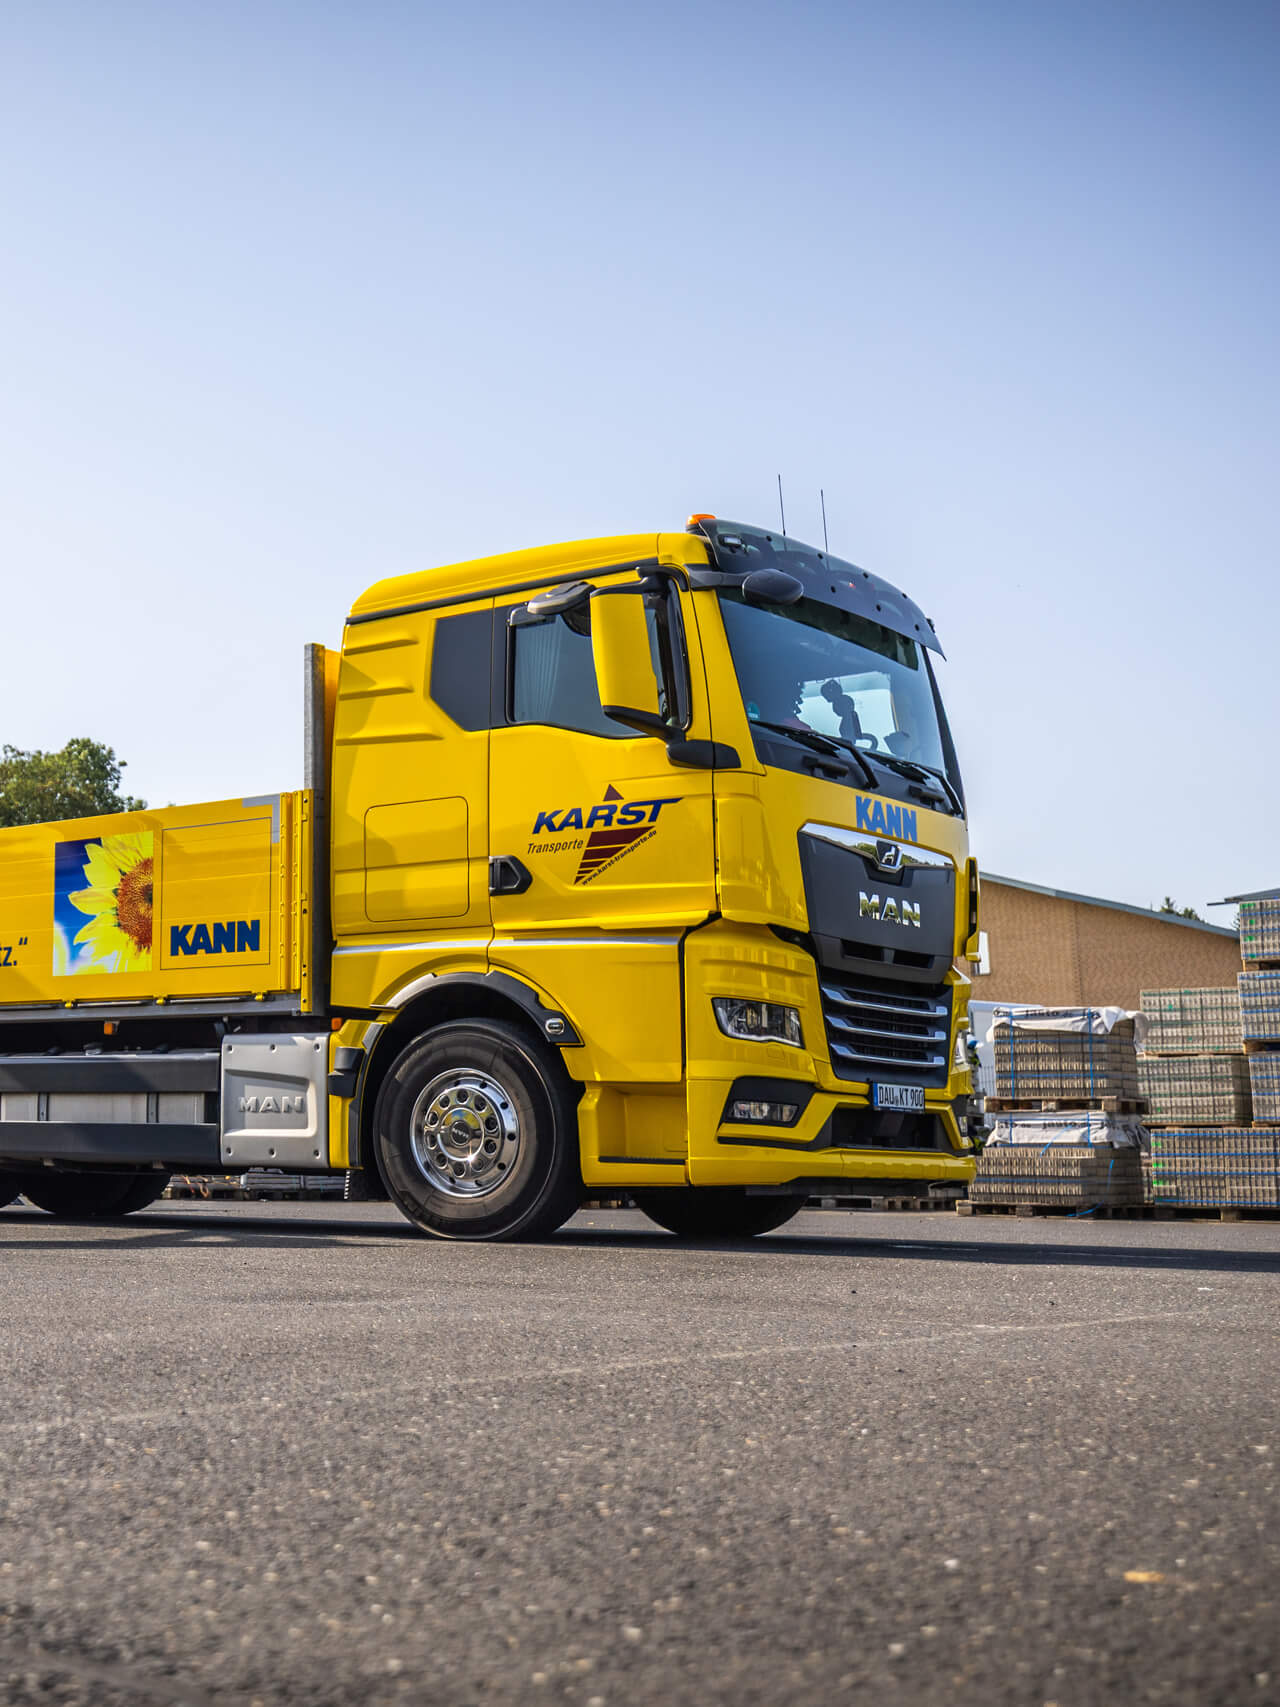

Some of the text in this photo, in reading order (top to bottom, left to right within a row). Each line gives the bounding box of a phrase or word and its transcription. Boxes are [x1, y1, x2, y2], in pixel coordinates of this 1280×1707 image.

[532, 797, 684, 835] KARST
[855, 795, 918, 843] KANN
[527, 838, 584, 855] Transporte
[859, 891, 920, 928] MAN
[170, 919, 260, 956] KANN
[239, 1095, 304, 1114] MAN
[879, 1086, 895, 1105] DAU
